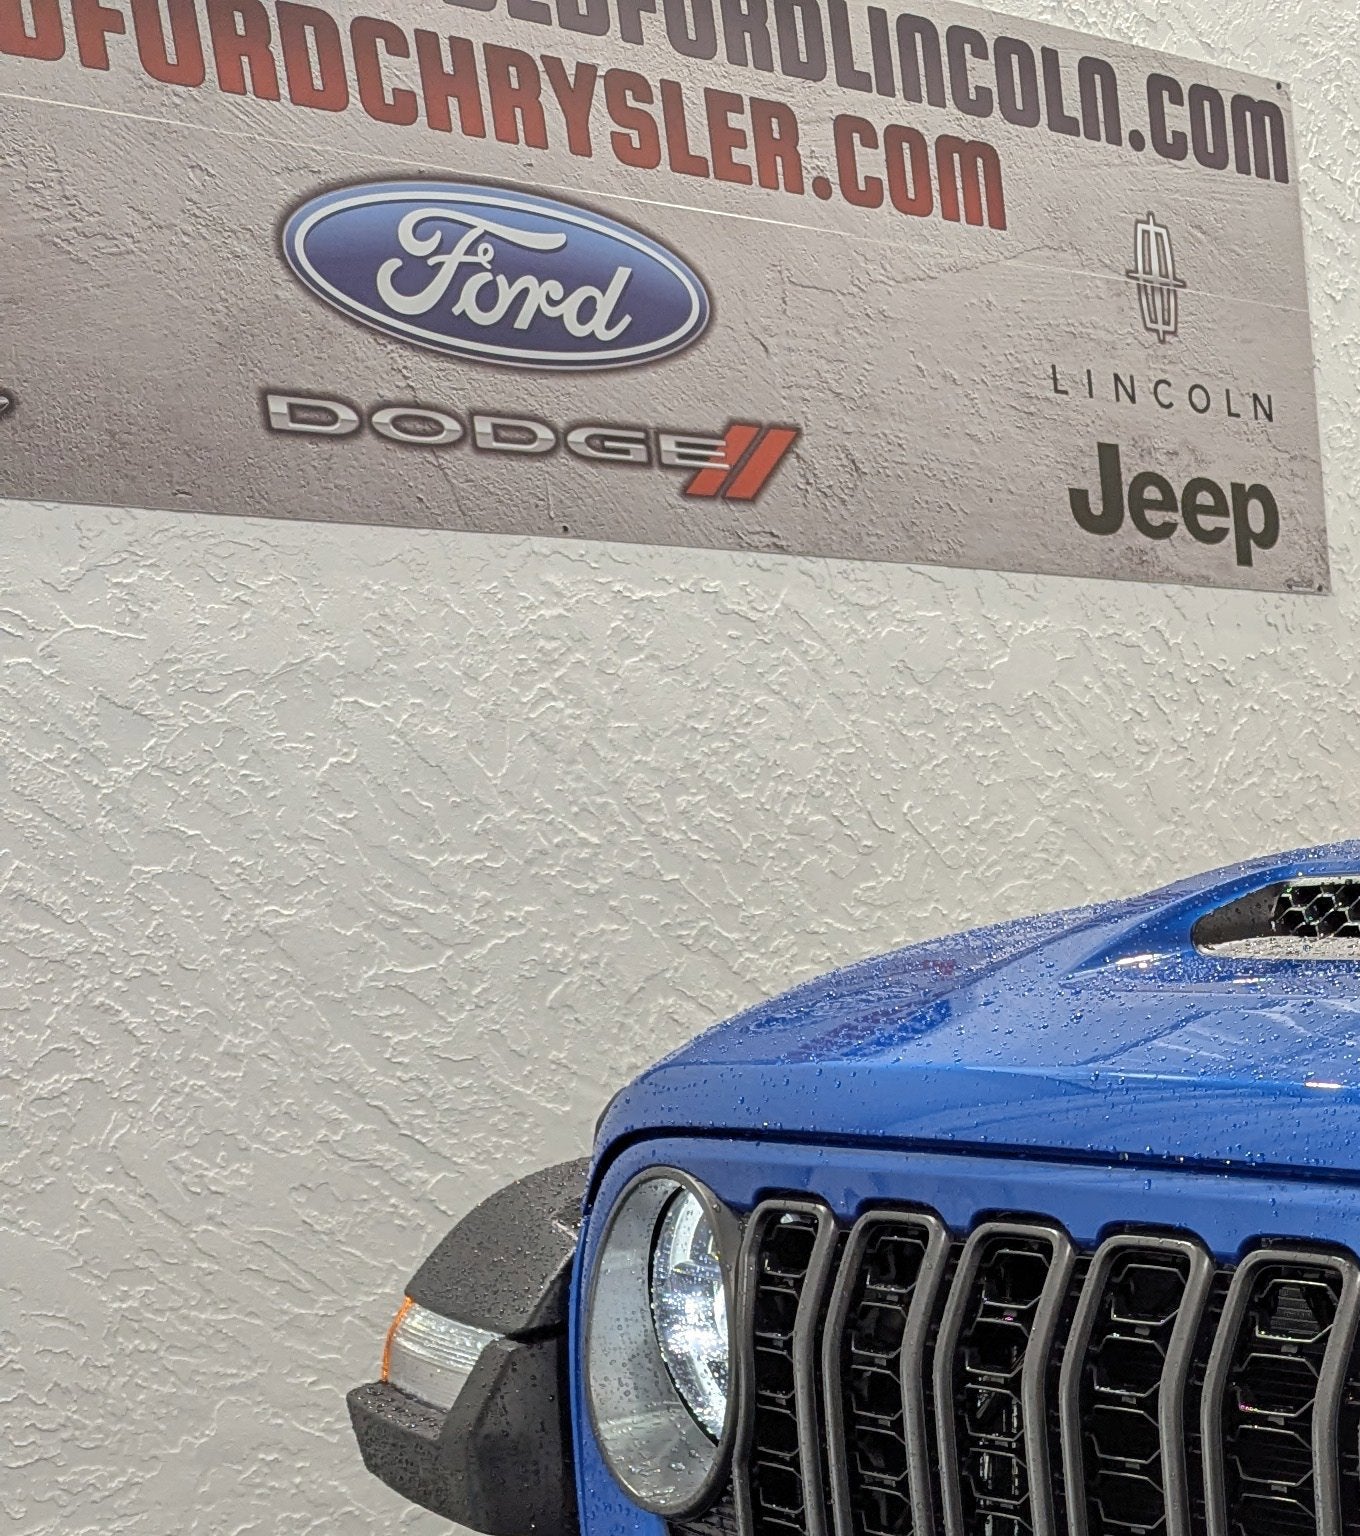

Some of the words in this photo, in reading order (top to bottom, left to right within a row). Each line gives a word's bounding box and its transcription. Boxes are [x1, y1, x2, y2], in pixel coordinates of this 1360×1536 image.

[443, 0, 1290, 185] ORDLINCOLN.COM
[376, 207, 632, 342] Ford
[266, 393, 732, 471] DODGE
[1051, 363, 1275, 423] LINCOLN
[1067, 440, 1281, 568] Jeep
